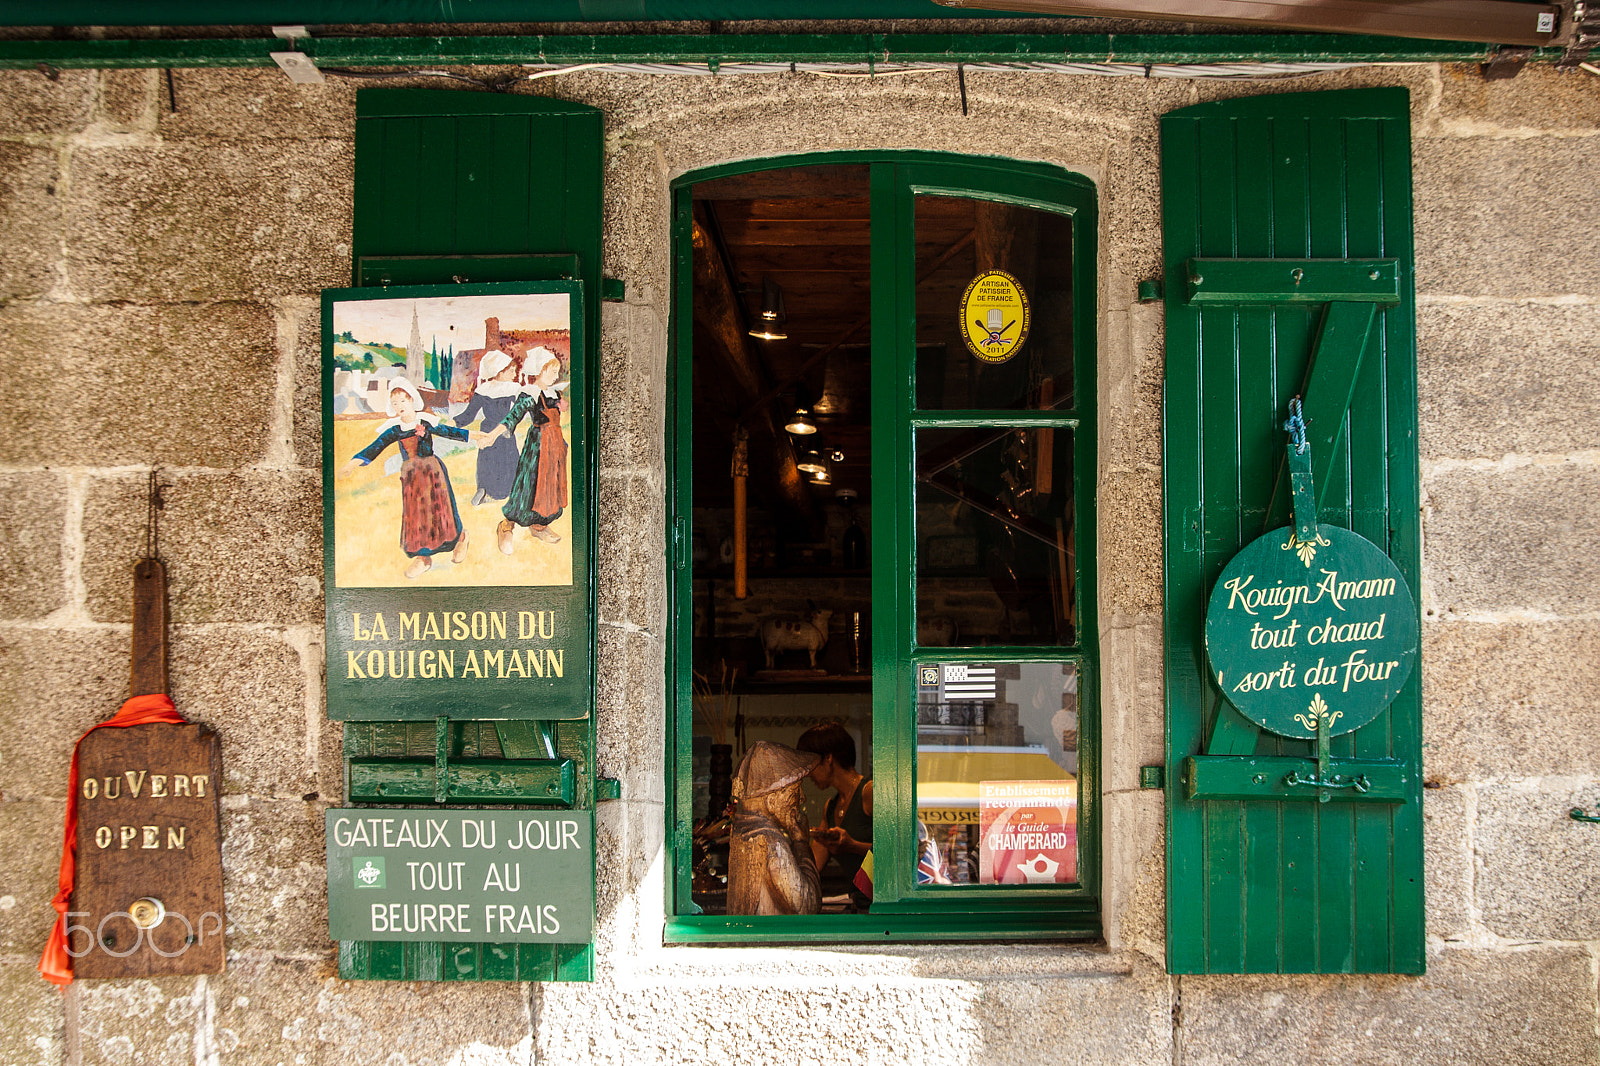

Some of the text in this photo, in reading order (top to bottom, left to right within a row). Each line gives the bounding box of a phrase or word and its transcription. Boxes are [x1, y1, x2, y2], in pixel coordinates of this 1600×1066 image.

[1224, 568, 1396, 620] Kouign Amann
[353, 610, 555, 641] LA MAISON DU
[1250, 613, 1386, 650] tout chaud
[346, 649, 564, 679] KOUIGN AMANN
[1233, 649, 1399, 693] sorti du four
[83, 770, 209, 800] OUVERT
[985, 785, 1070, 797] Etablissement
[1006, 822, 1049, 832] le Guide
[1020, 813, 1034, 821] par
[95, 825, 187, 849] OPEN
[333, 817, 581, 850] GATEAUX DU JOUR
[988, 832, 1067, 850] CHAMPERARD
[406, 862, 521, 892] TOUT AU
[371, 904, 560, 934] BEURRE FRAIS
